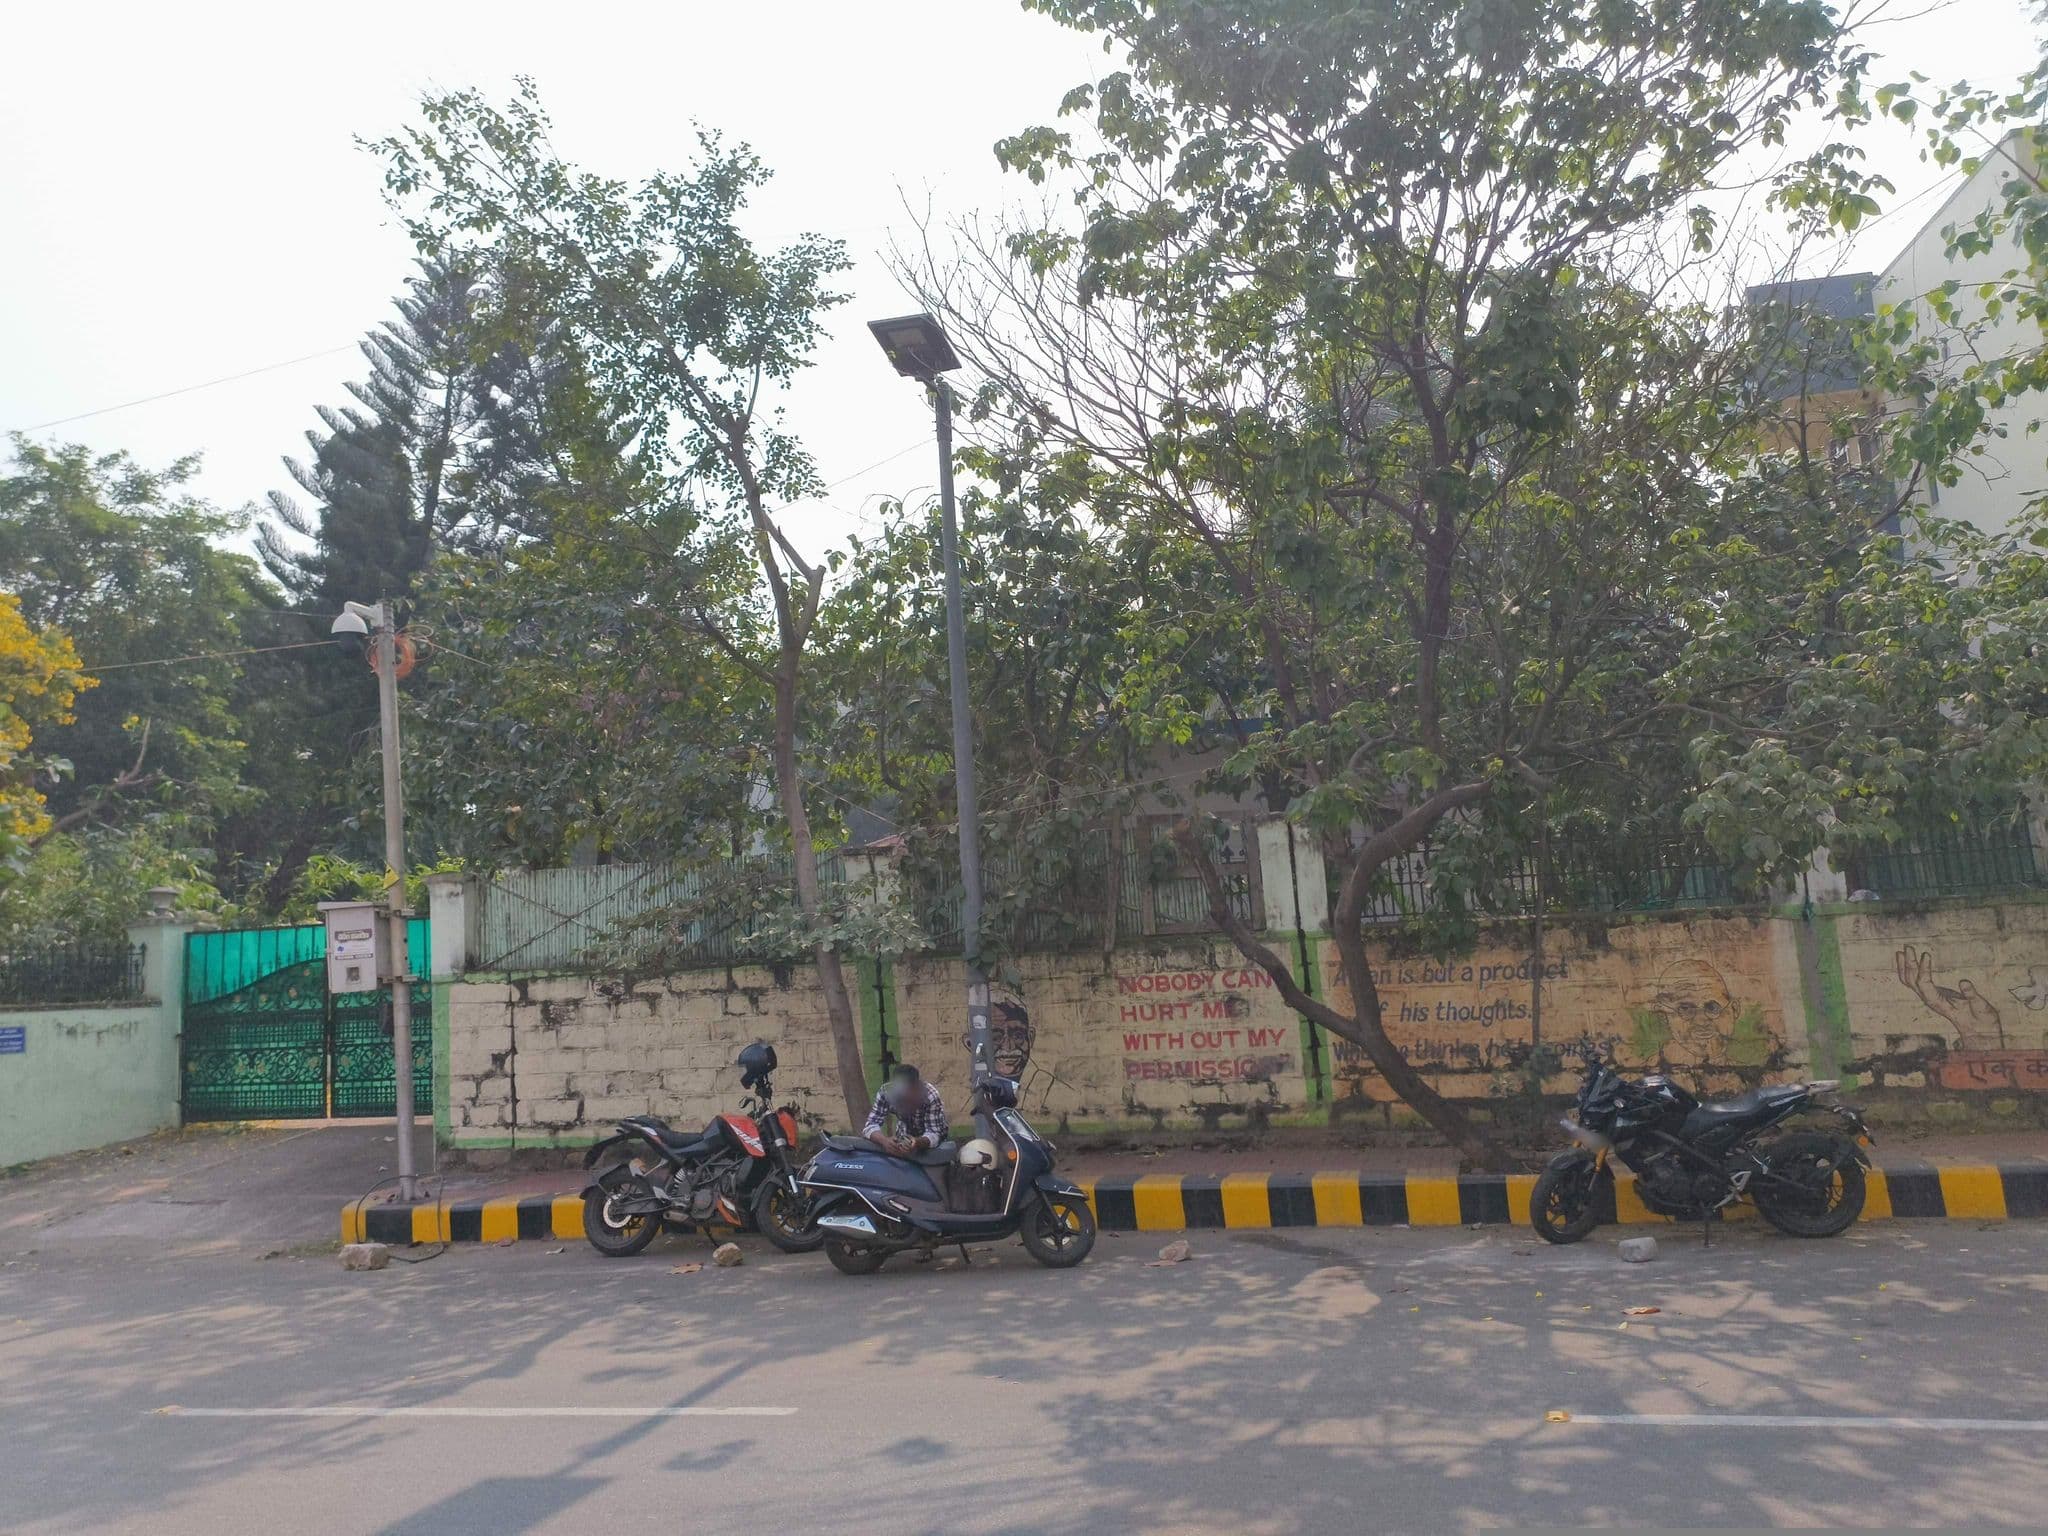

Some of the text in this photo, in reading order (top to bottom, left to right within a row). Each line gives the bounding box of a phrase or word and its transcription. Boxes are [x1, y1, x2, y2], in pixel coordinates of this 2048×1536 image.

[1117, 969, 1273, 993] NOBODY CAN
[1398, 961, 1414, 984] is
[1423, 960, 1455, 983] but
[1461, 966, 1473, 982] a
[1120, 1003, 1192, 1021] HURT
[1400, 1001, 1429, 1022] his
[1436, 999, 1532, 1028] thoughts.
[1123, 1028, 1286, 1050] WITH OUT MY
